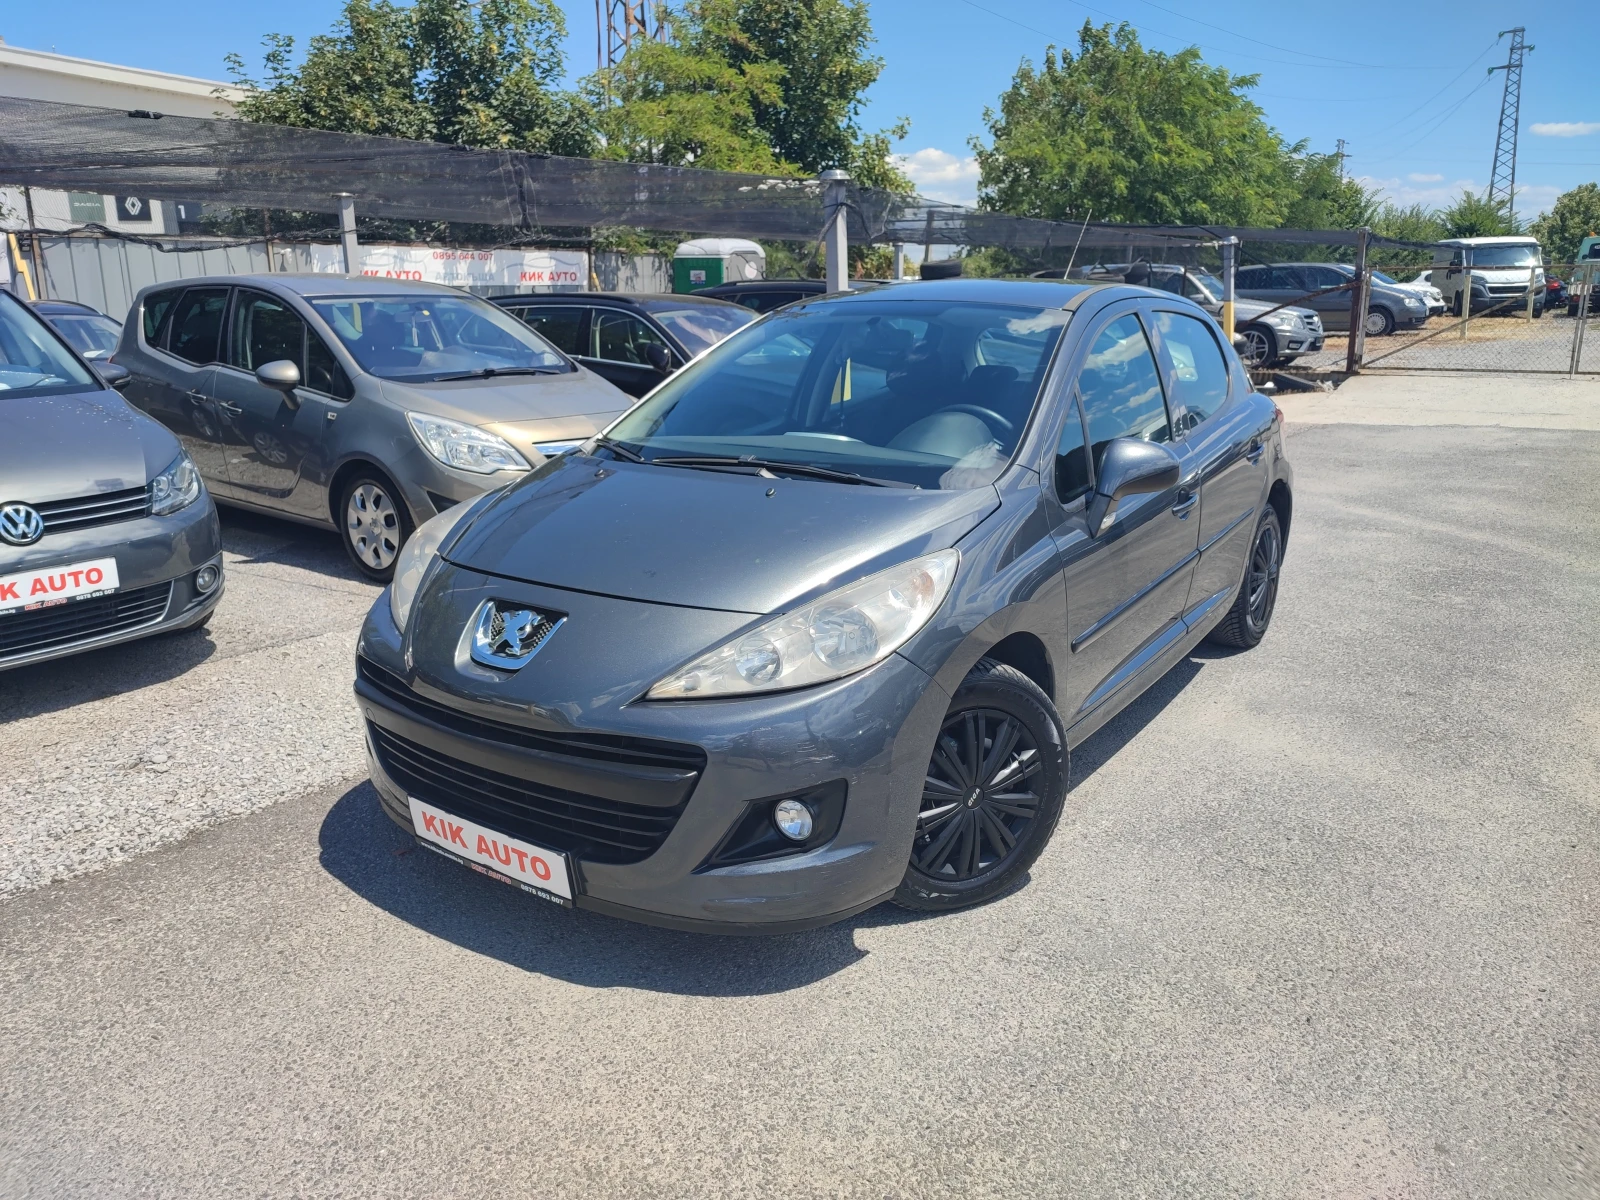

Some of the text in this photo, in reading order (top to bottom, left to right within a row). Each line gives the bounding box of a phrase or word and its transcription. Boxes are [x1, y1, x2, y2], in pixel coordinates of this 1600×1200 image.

[432, 251, 457, 260] 0895
[477, 252, 494, 261] 007
[520, 271, 577, 282] КИК АУТО
[29, 567, 104, 597] AUTO
[421, 810, 469, 850] KIK
[476, 834, 553, 882] AUTO
[550, 896, 564, 905] 007
